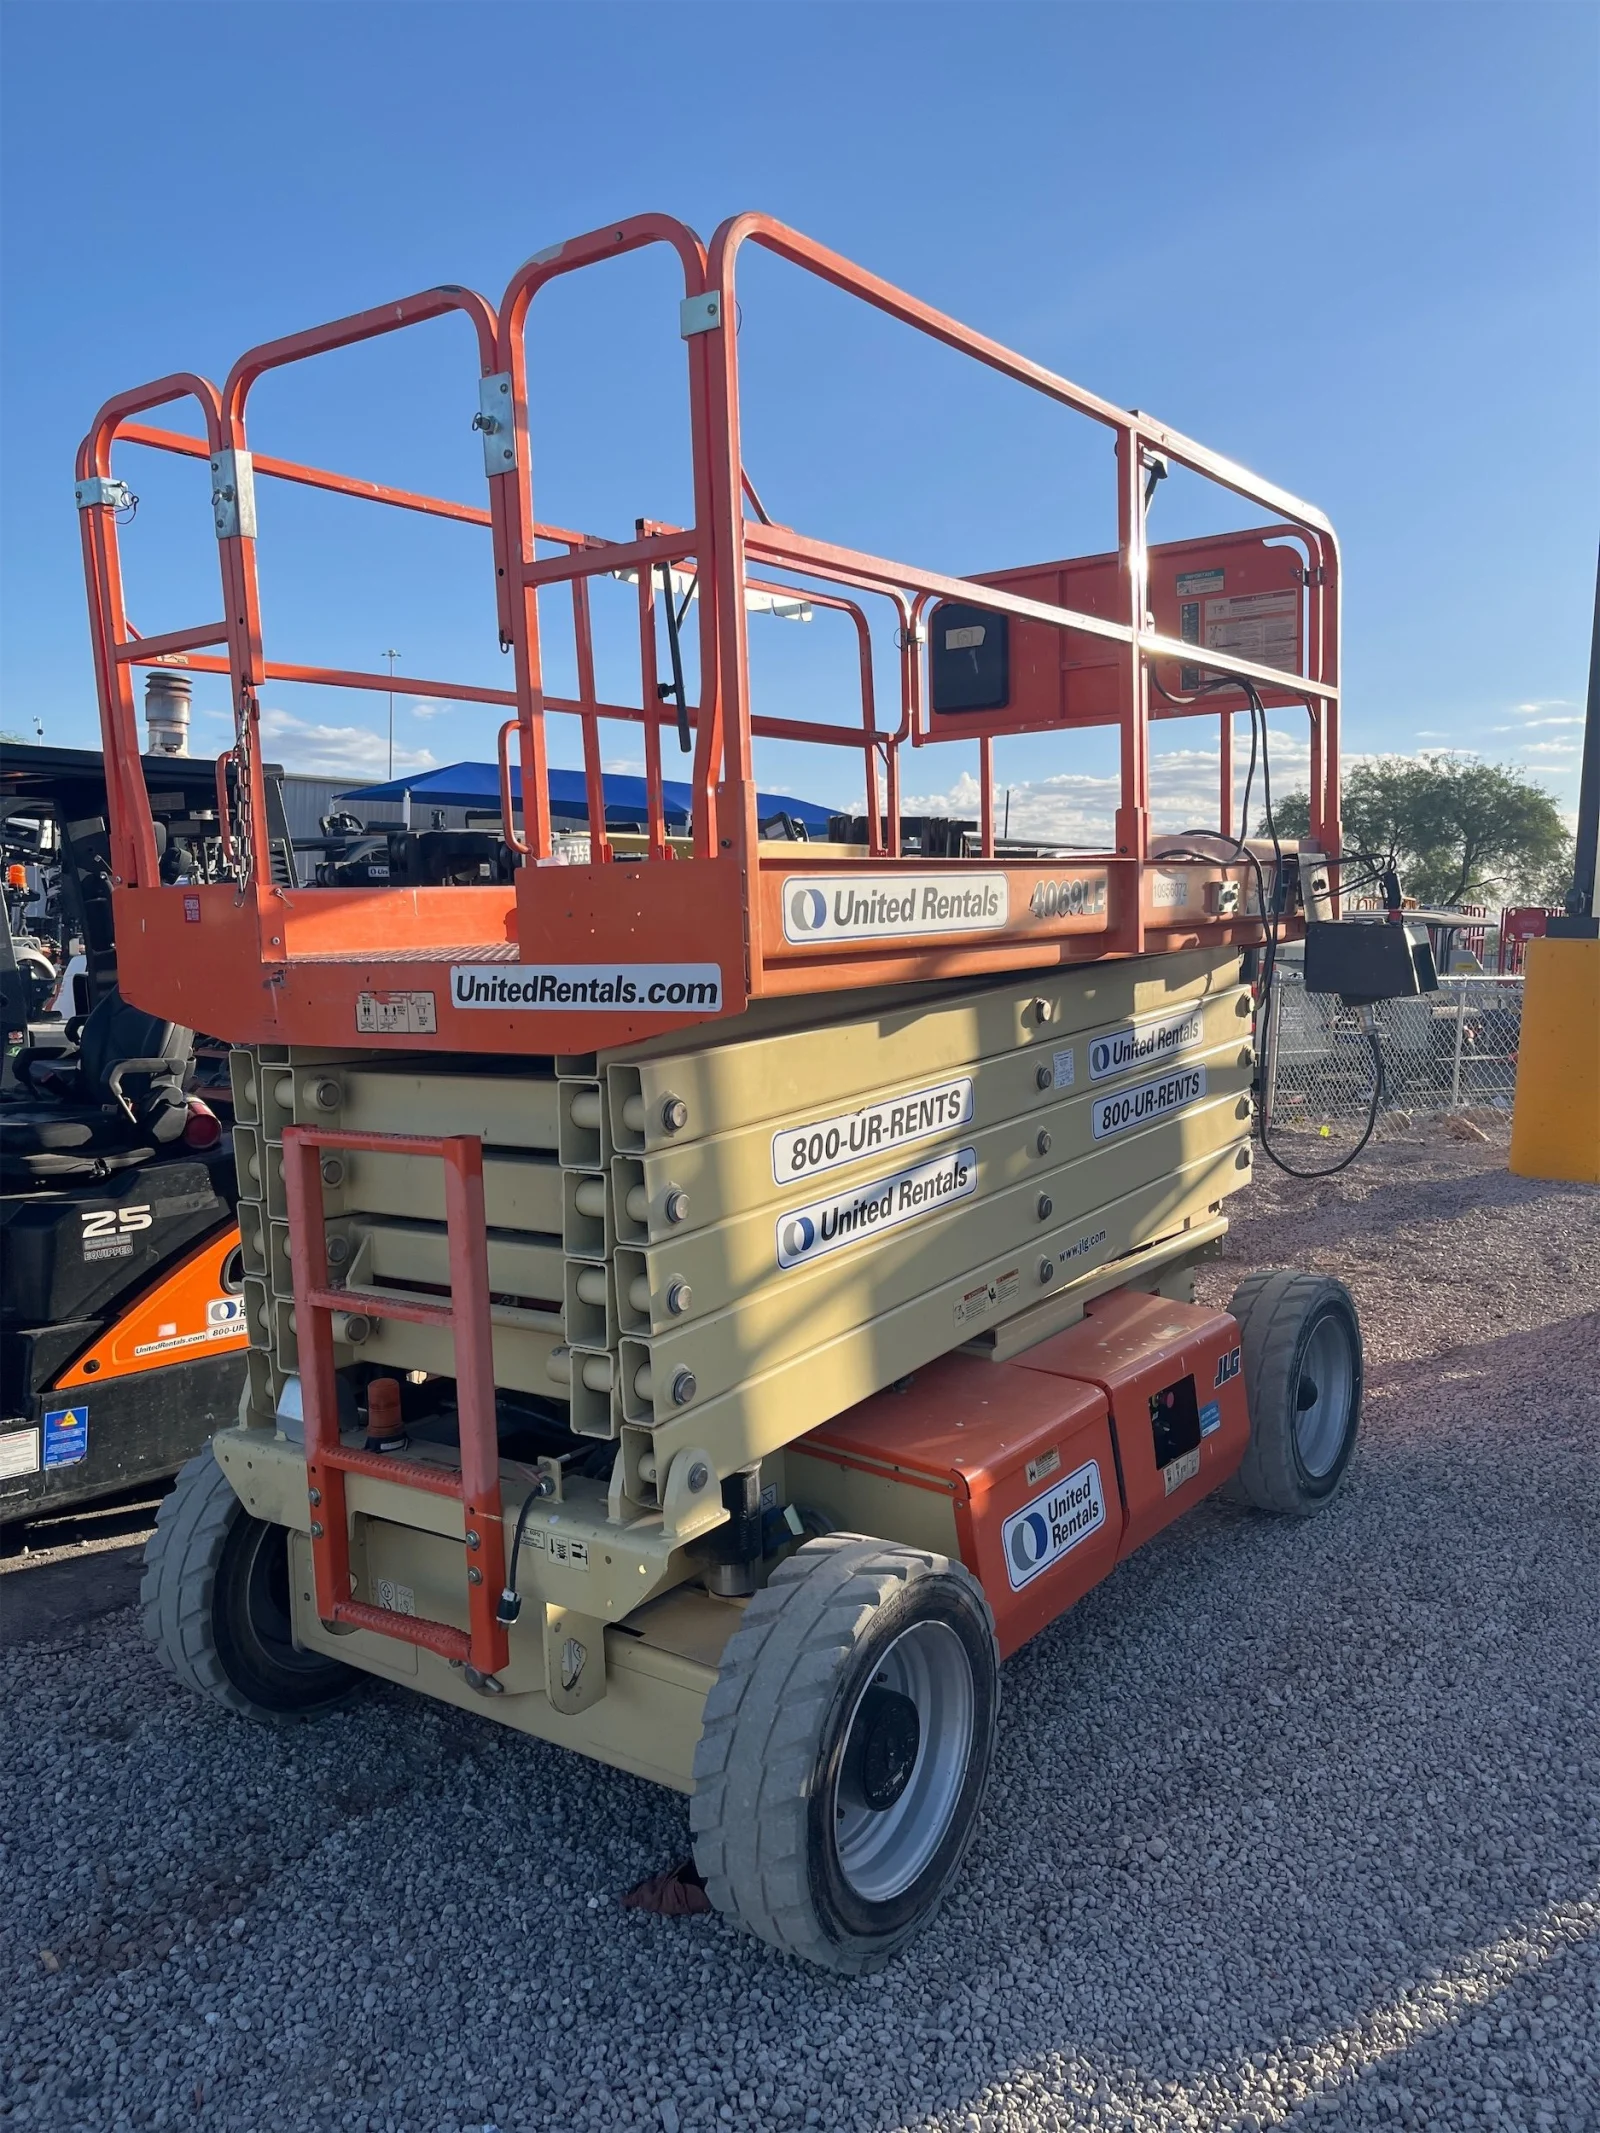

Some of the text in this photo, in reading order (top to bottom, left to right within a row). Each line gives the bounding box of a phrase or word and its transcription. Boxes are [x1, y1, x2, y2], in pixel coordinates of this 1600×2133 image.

[834, 885, 999, 926] United Rentals
[1029, 878, 1106, 918] 4069LE
[456, 975, 718, 1005] UnitedRentals.com
[1113, 1018, 1199, 1064] United Rentals
[1102, 1072, 1200, 1129] 800-UR-RENTS
[791, 1089, 961, 1171] 800-UR-RENTS
[82, 1204, 152, 1238] 25
[821, 1162, 968, 1241] United Rentals
[84, 1245, 132, 1261] EQUIPPED
[1059, 1229, 1107, 1263] www.jlg.com
[135, 1334, 206, 1354] UnitedRentals.com
[1214, 1345, 1242, 1389] JLG
[1048, 1475, 1091, 1523] United
[1052, 1499, 1099, 1548] Rentals
